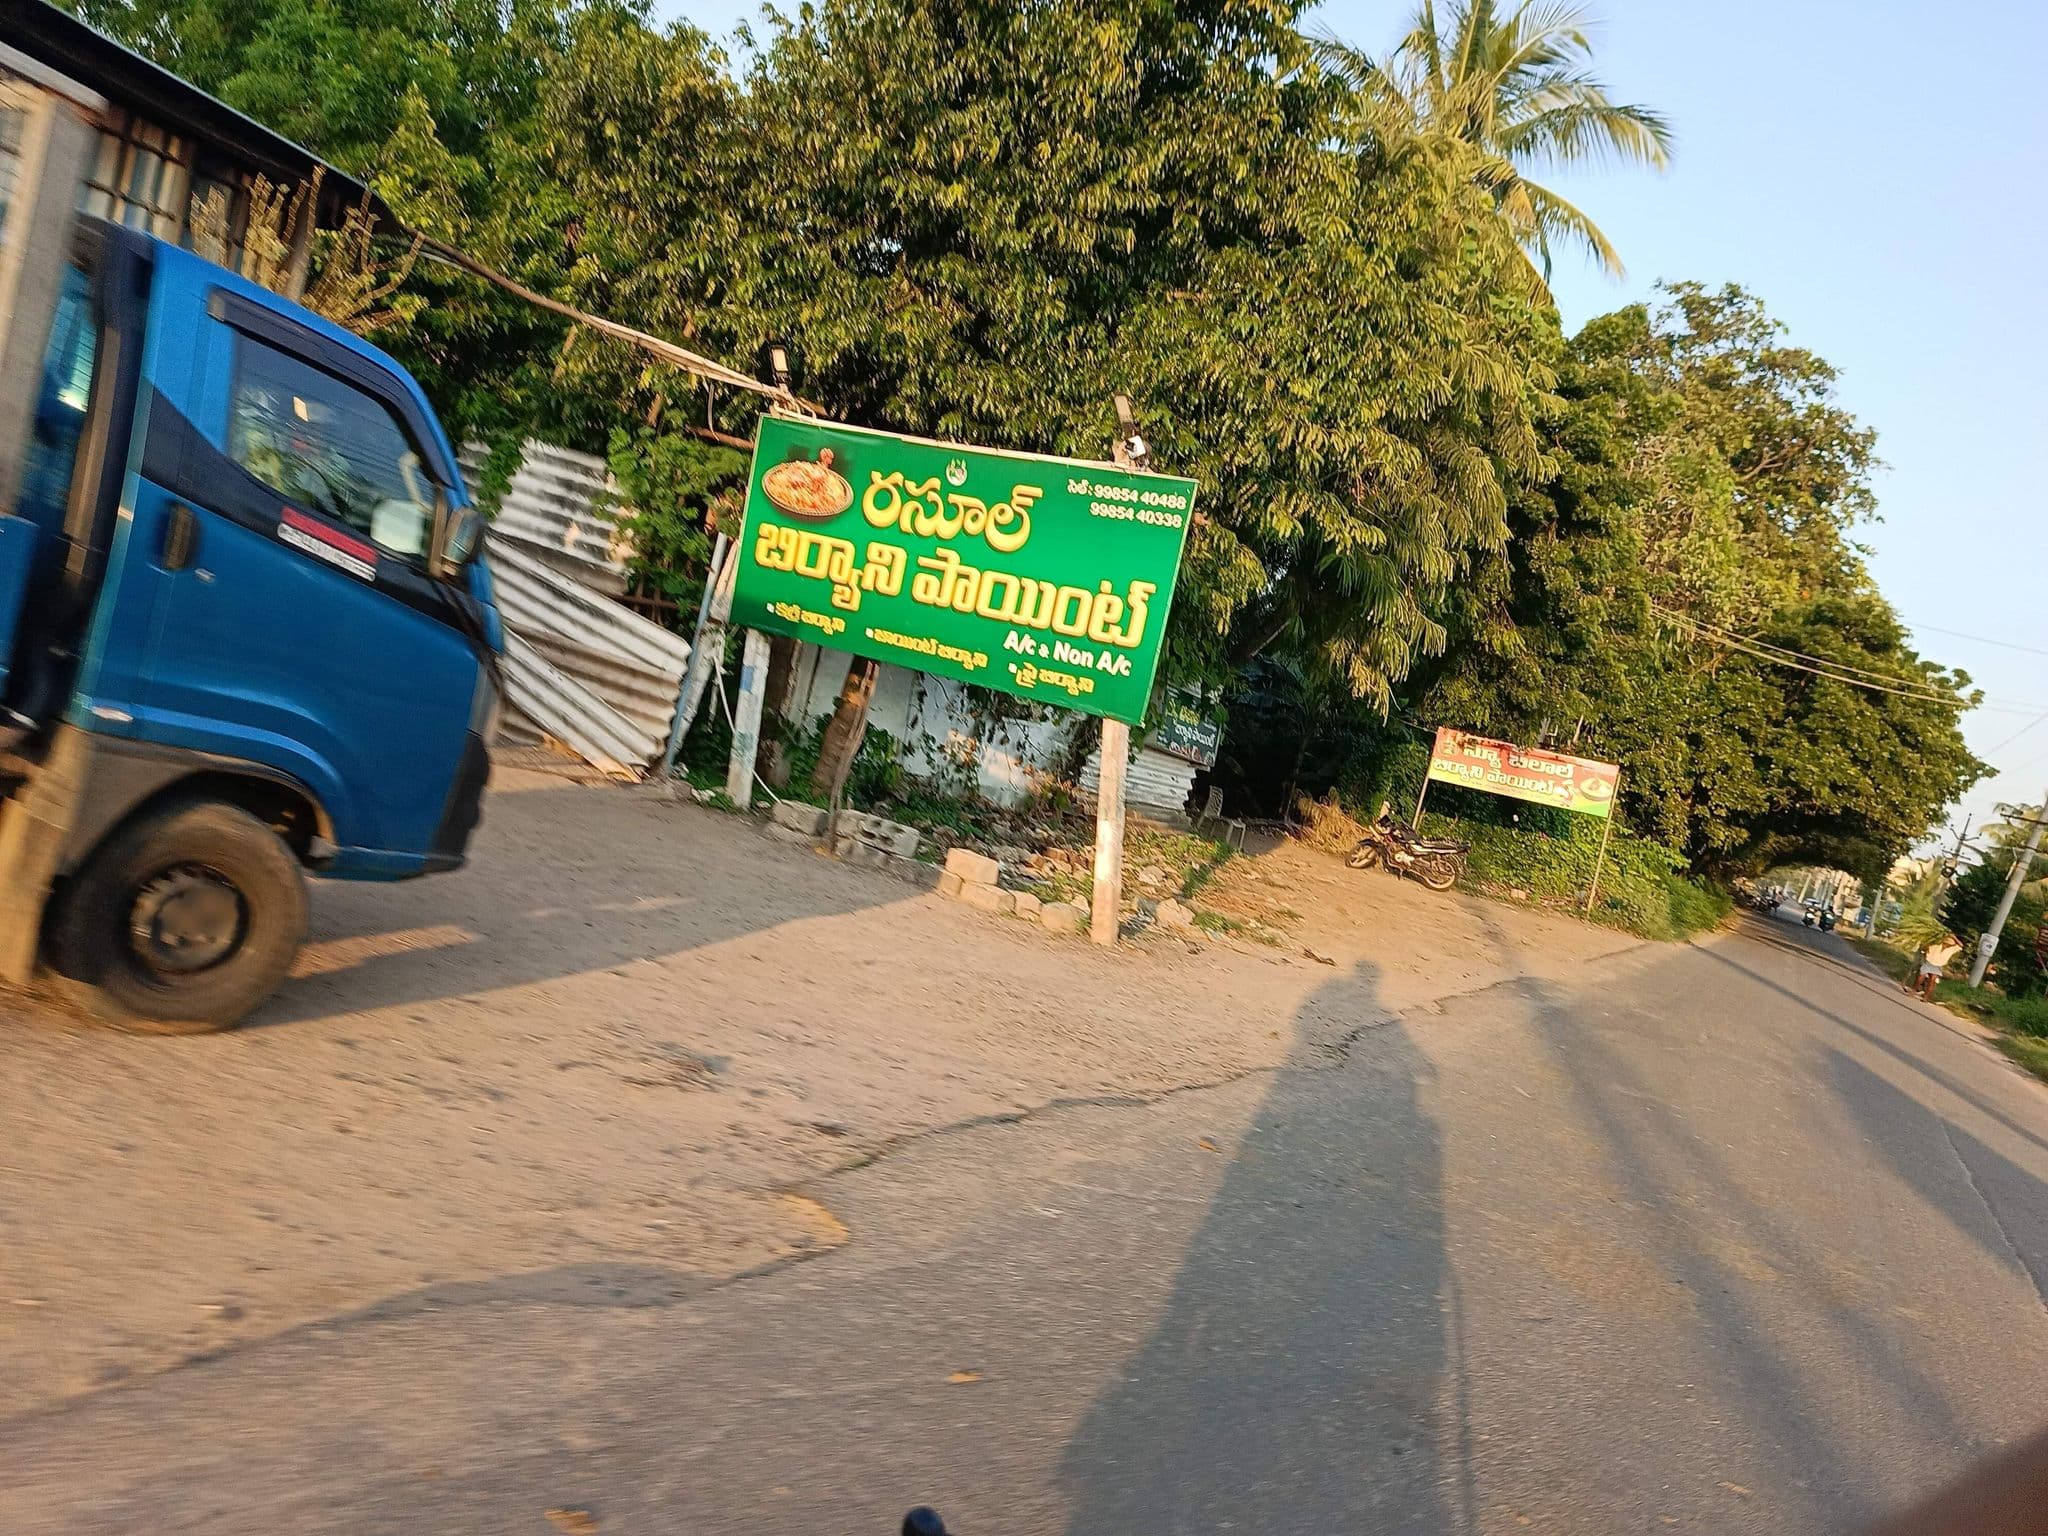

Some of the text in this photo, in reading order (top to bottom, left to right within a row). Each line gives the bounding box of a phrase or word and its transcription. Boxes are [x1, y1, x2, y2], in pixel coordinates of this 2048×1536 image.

[862, 470, 1043, 552] రసూల్
[1090, 502, 1182, 528] 99854 40338
[1094, 484, 1139, 503] 99854
[755, 522, 1157, 648] బిర్యాని పాయింట్
[1003, 630, 1133, 677] A/c & Non A/c
